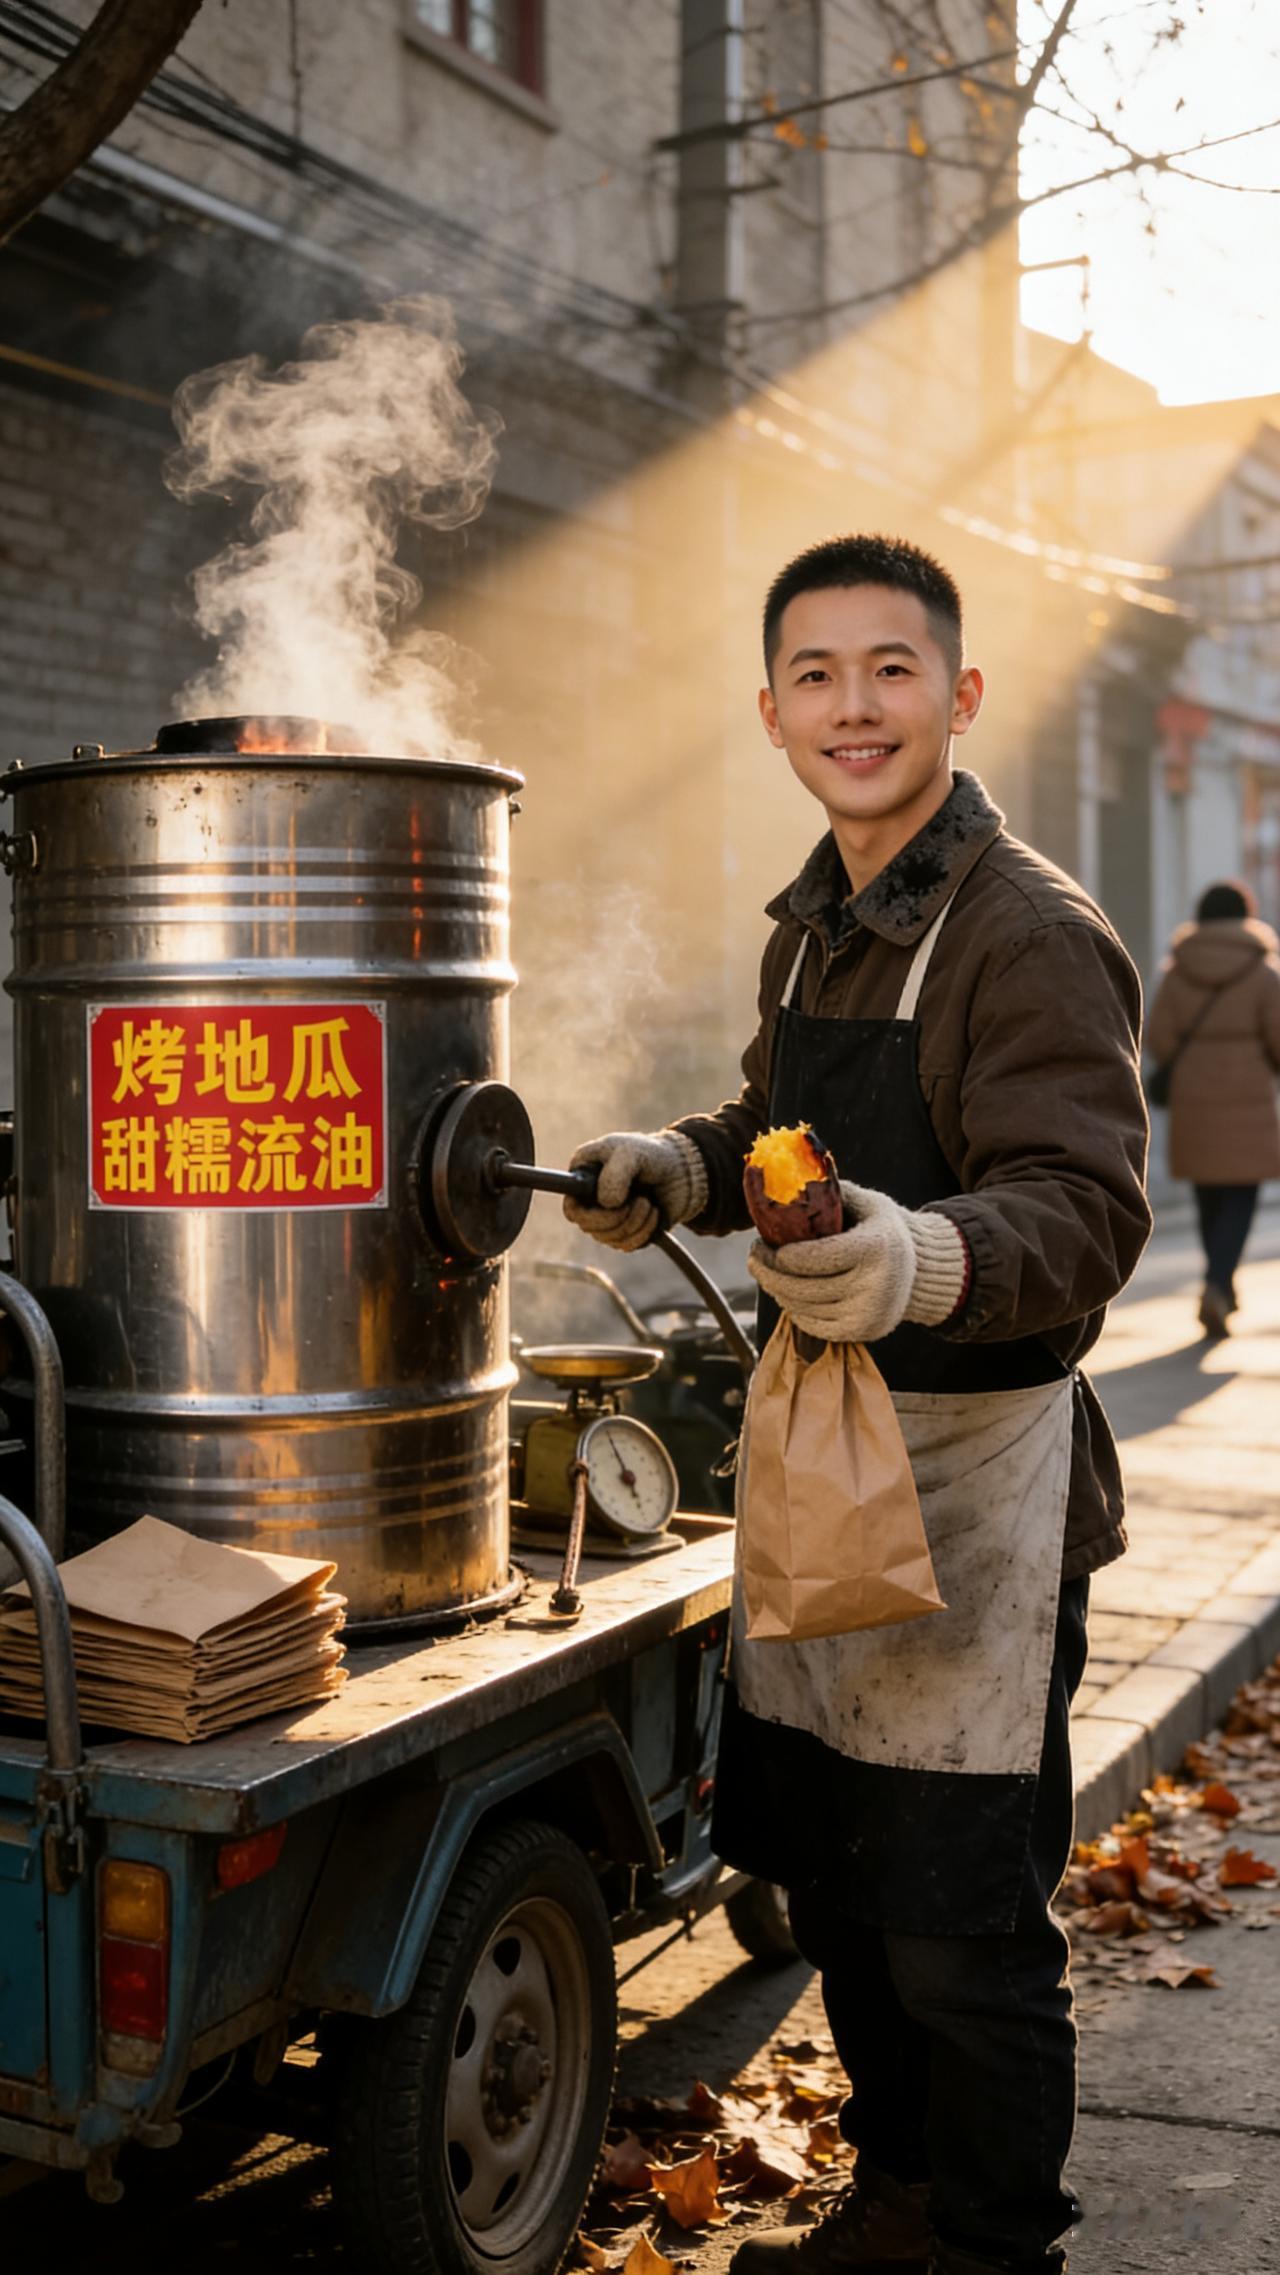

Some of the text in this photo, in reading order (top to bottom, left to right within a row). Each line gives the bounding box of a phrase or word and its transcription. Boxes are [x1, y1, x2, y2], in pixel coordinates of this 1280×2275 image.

[112, 1017, 362, 1105] 烤地瓜
[102, 1112, 372, 1193] 甜糯流油
